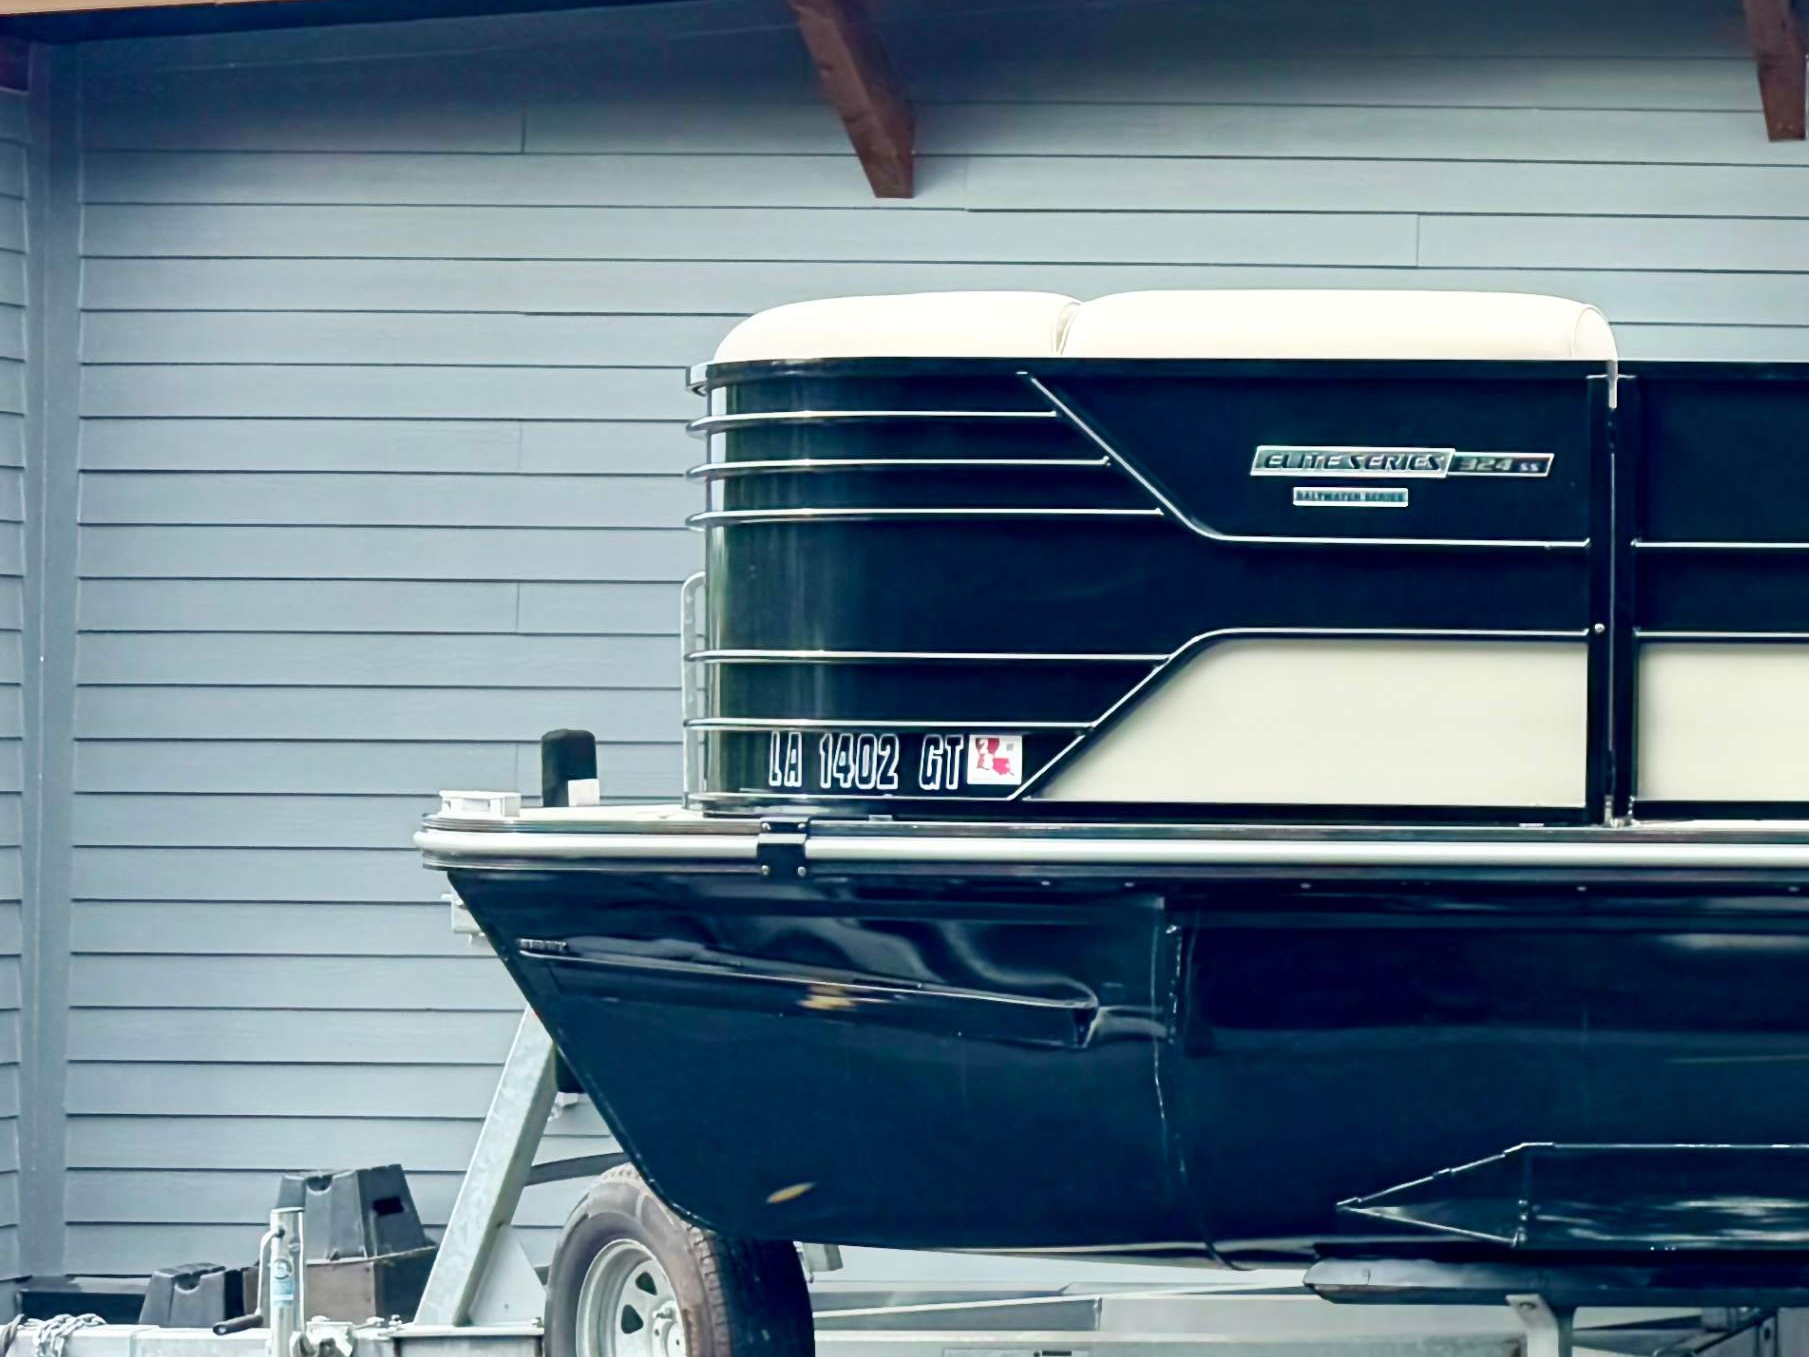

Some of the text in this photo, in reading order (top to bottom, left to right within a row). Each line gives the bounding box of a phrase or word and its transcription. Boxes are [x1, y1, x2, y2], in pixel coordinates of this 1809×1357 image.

[1264, 452, 1345, 469] ELITE
[1349, 454, 1446, 471] SERIES
[1458, 457, 1514, 472] 324
[768, 731, 802, 787] LA
[819, 733, 900, 790] 1402
[918, 733, 964, 790] GT
